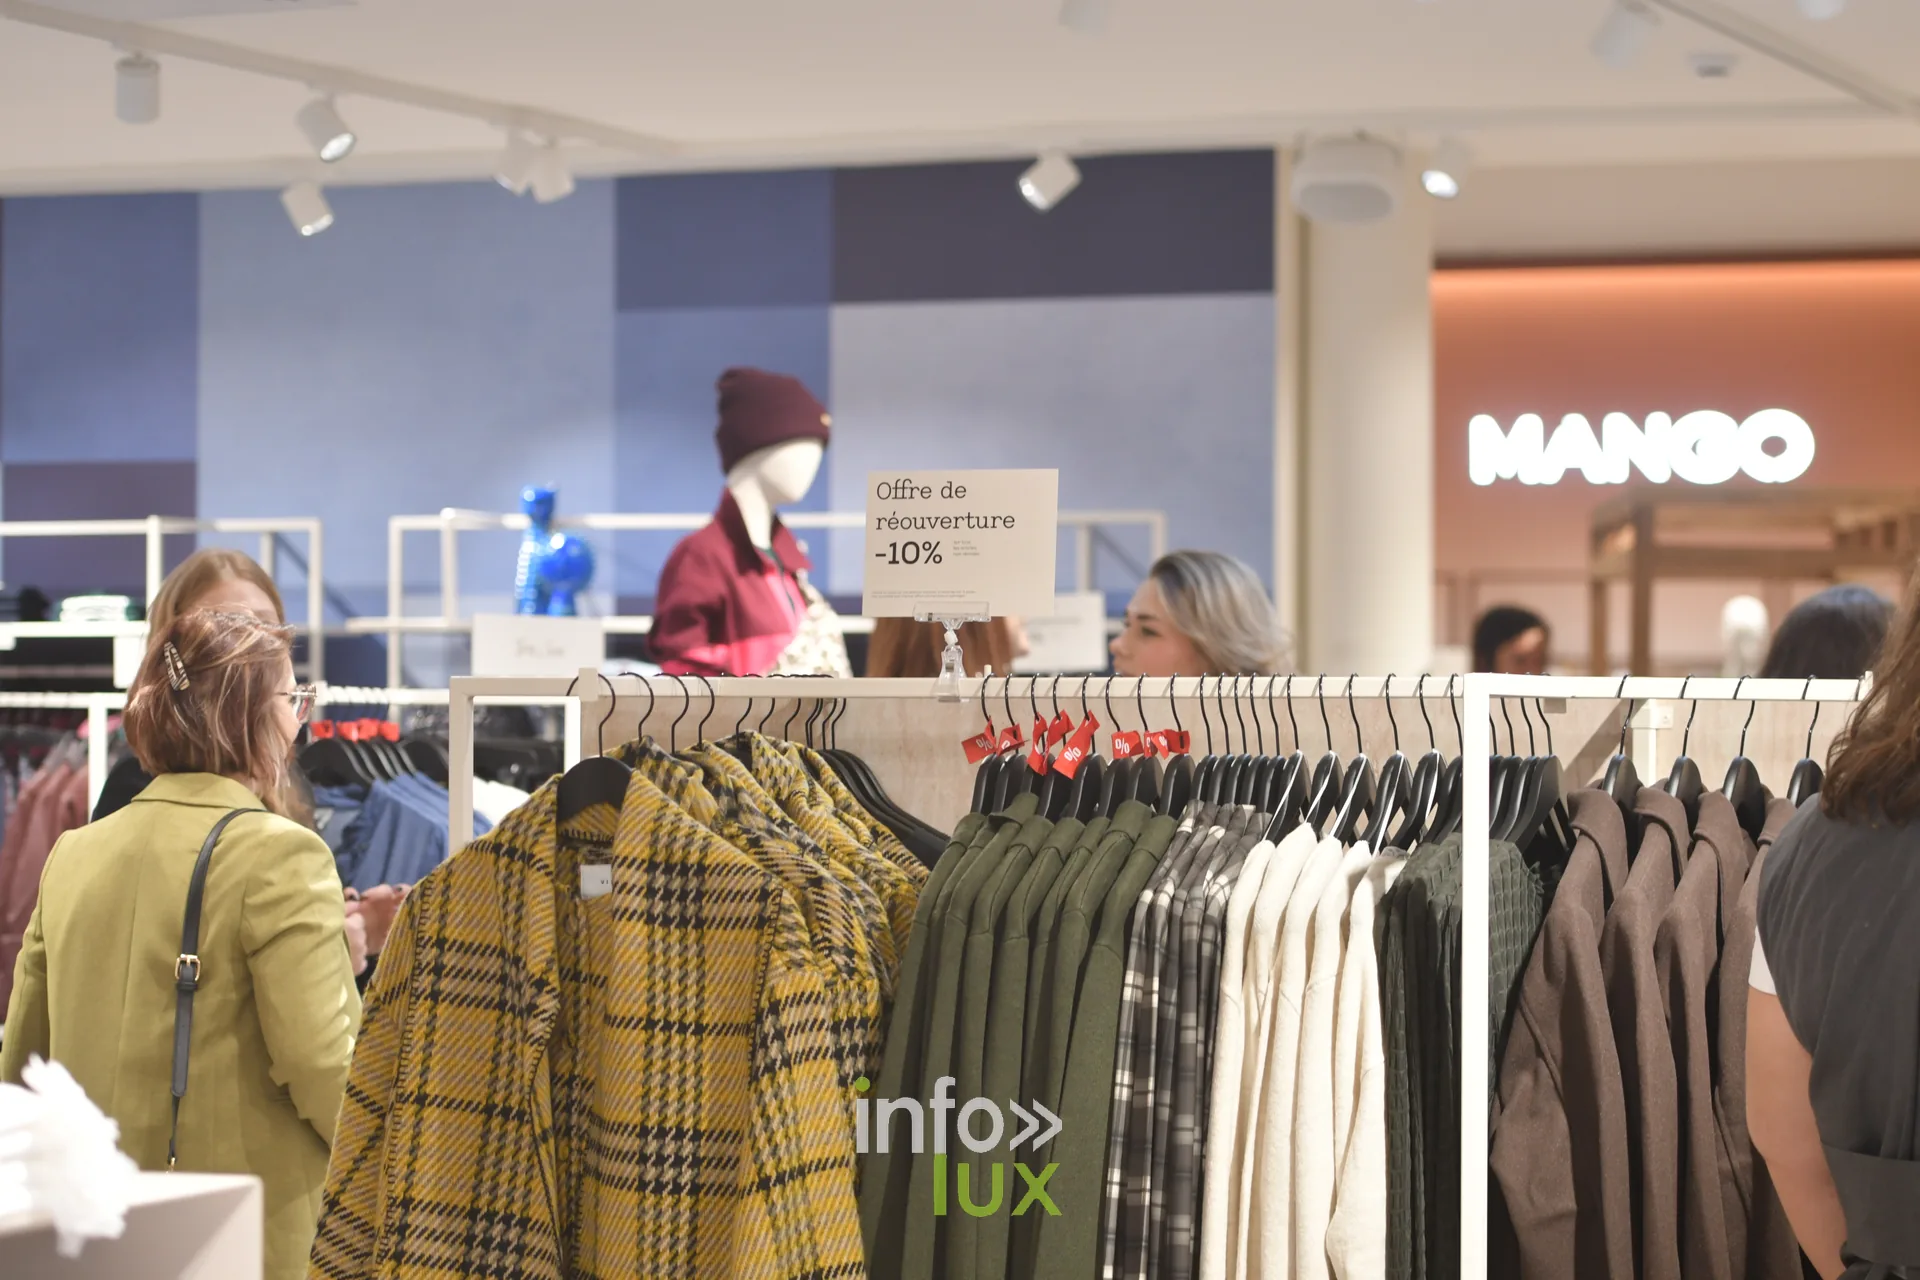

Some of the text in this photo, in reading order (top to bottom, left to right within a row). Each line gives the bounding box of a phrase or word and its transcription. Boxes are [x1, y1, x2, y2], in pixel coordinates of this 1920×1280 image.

[1469, 408, 1815, 486] MANGO
[876, 478, 967, 500] Offre de
[875, 511, 1015, 531] réouverture
[875, 541, 943, 565] -10%
[1064, 746, 1082, 762] %
[1115, 738, 1130, 755] %
